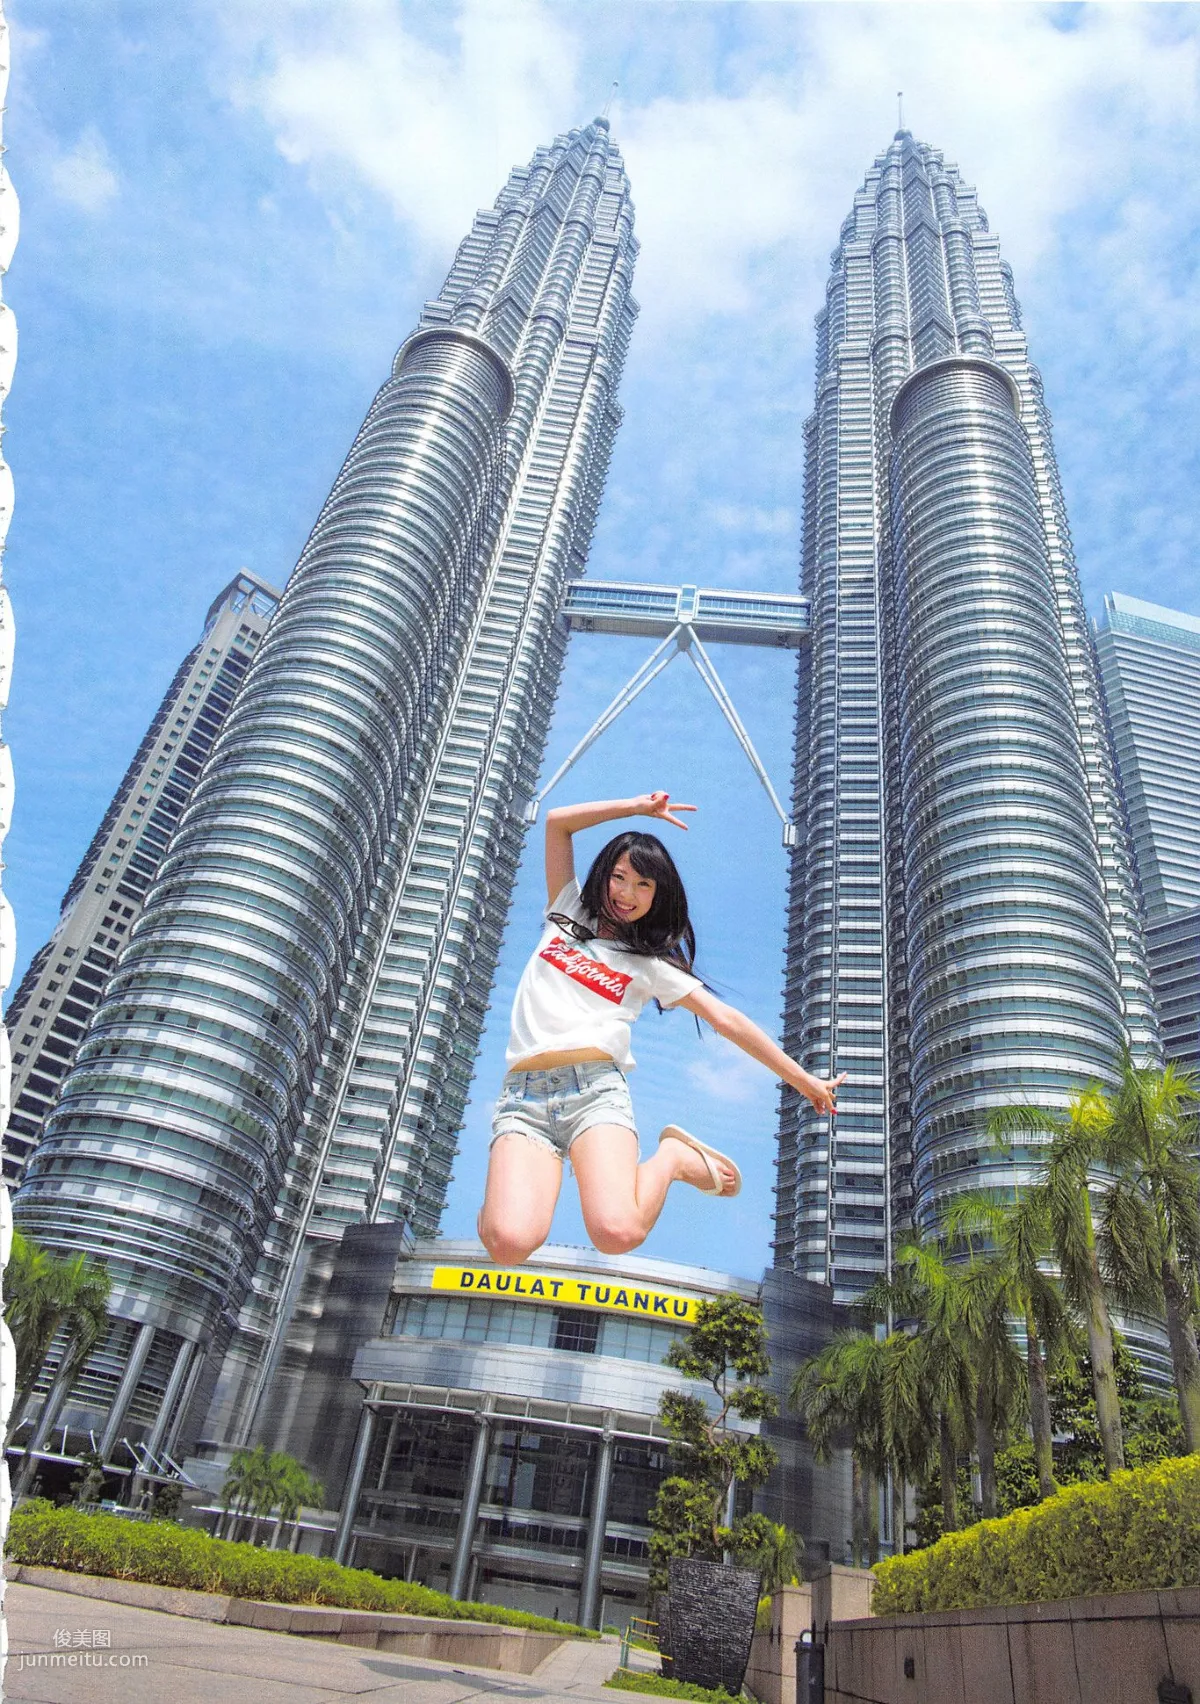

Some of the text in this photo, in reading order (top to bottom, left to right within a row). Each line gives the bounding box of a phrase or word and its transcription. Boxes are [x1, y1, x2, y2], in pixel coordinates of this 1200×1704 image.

[542, 942, 624, 997] California
[460, 1271, 688, 1317] DAULAT TUANKU
